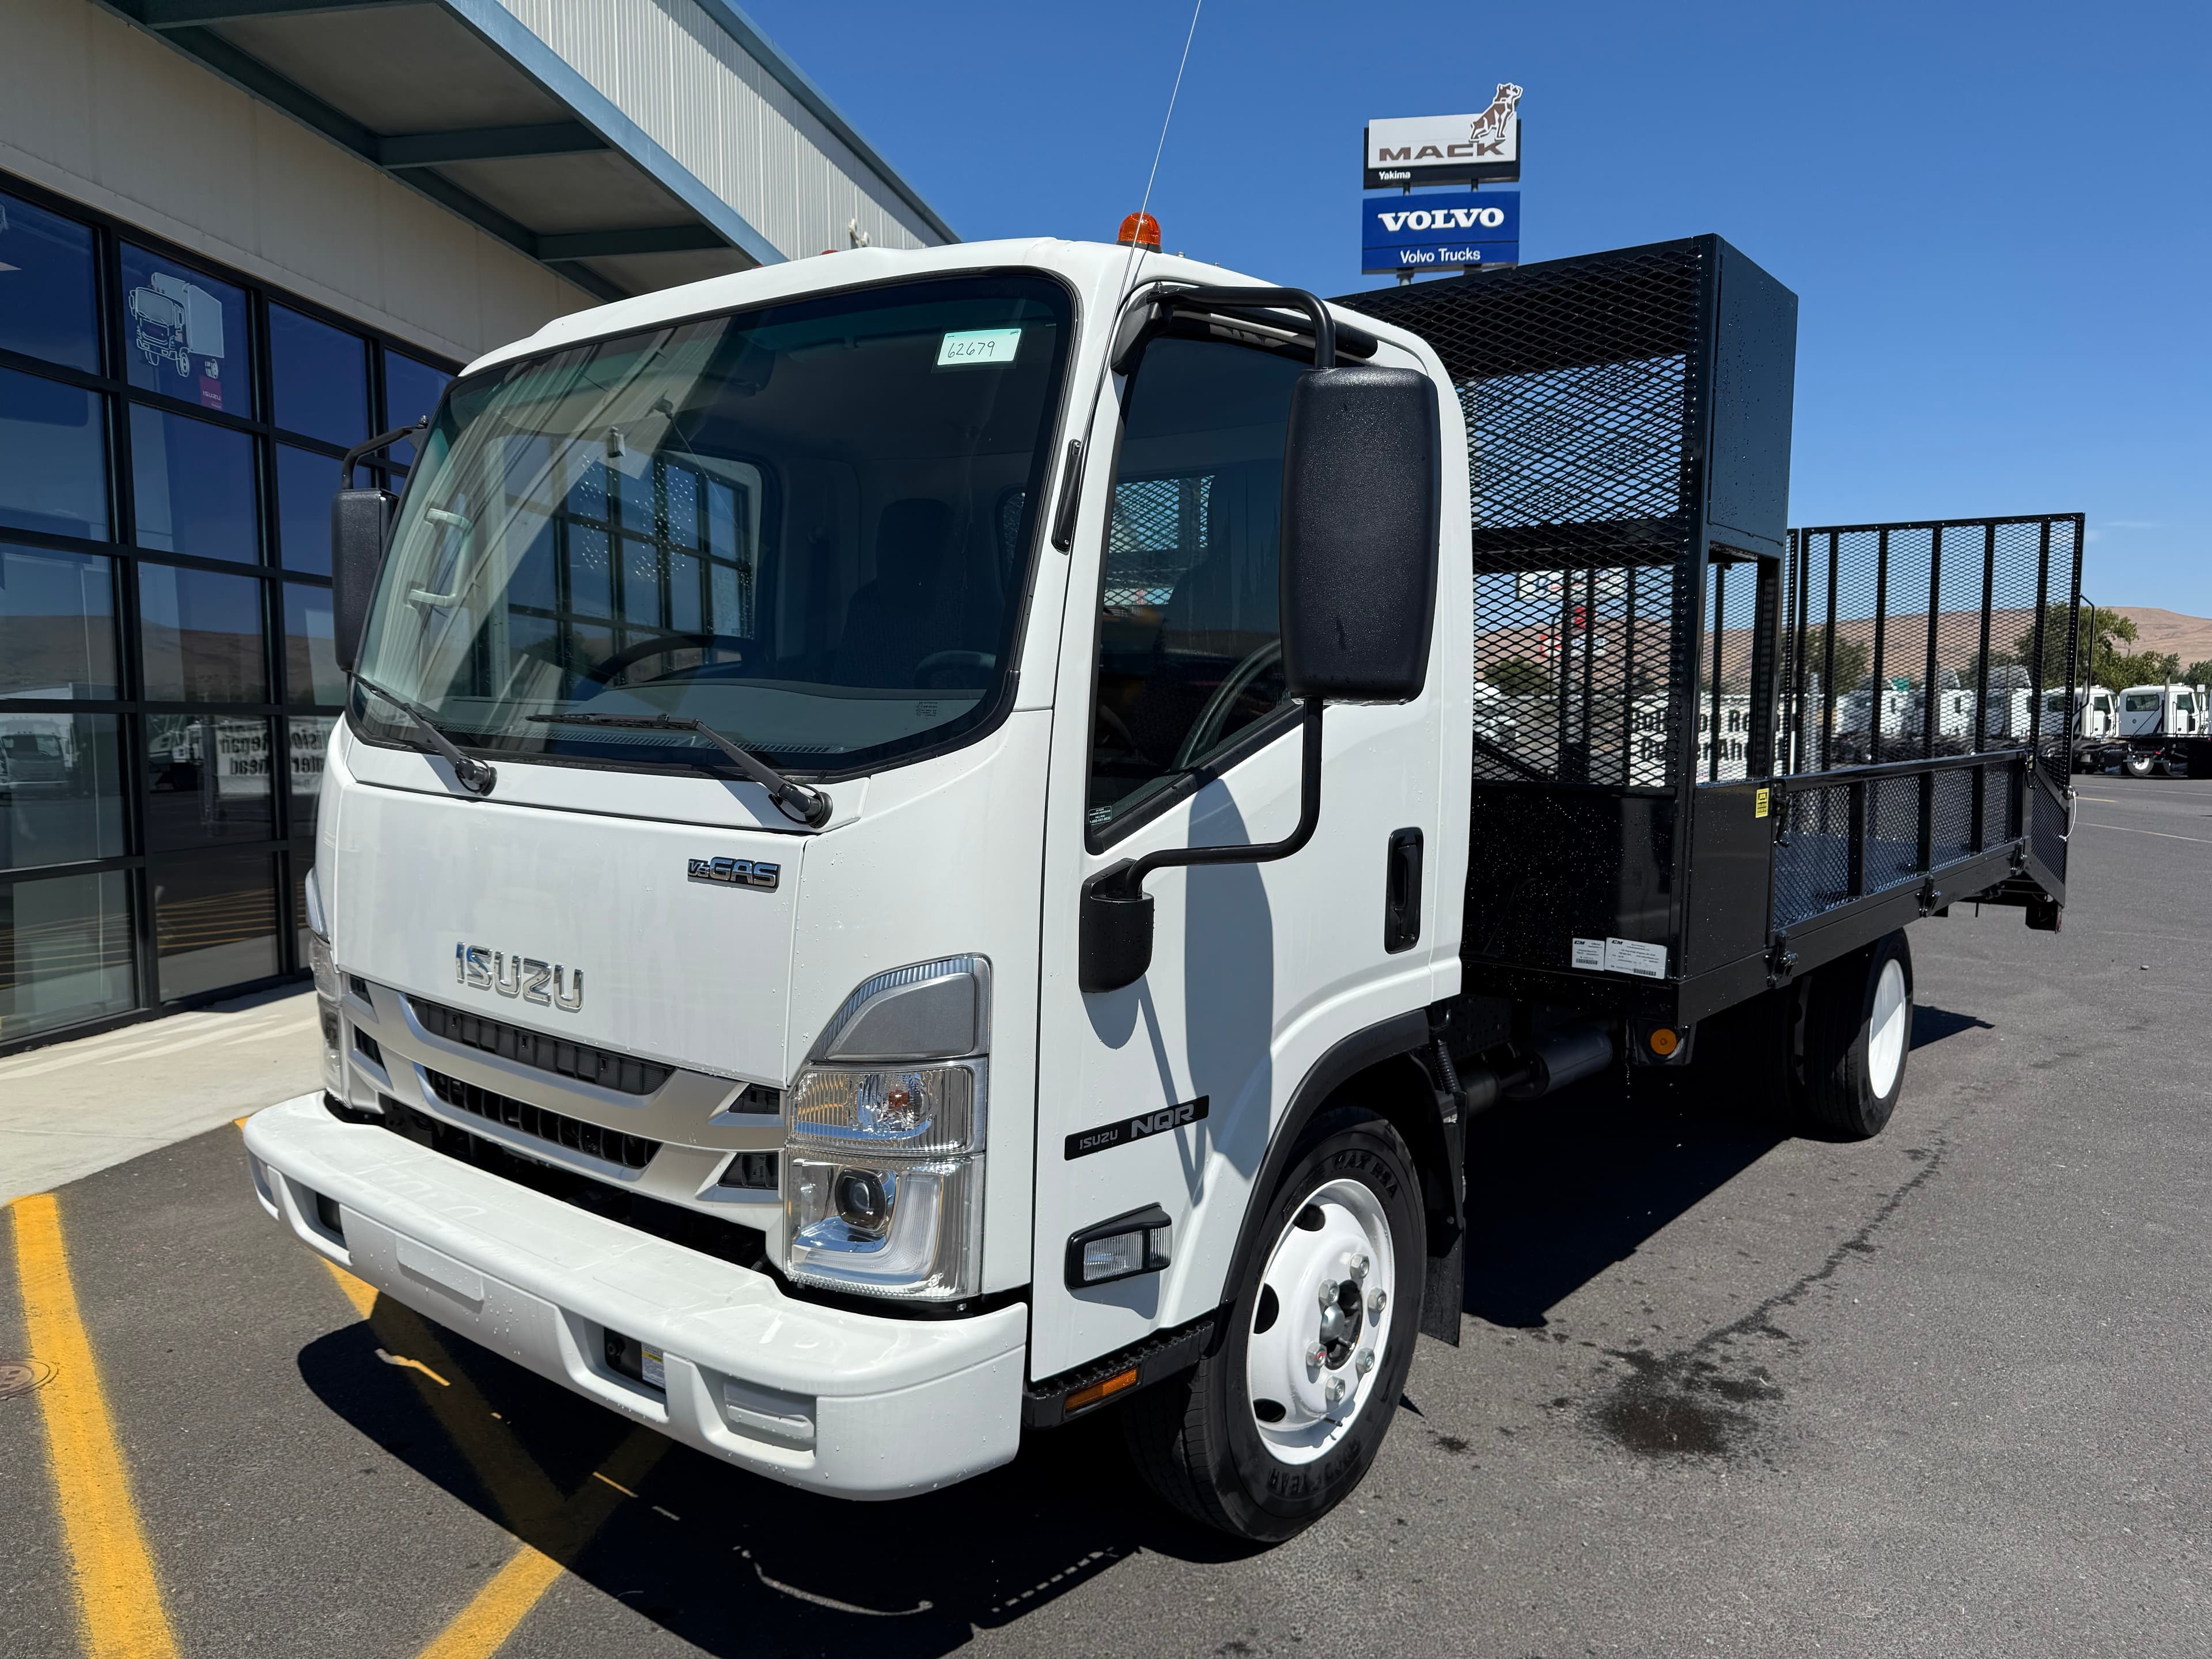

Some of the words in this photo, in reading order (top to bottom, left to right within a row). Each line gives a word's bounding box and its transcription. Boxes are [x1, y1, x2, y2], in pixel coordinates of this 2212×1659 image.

[1379, 142, 1505, 161] MACK
[1378, 171, 1411, 180] Yakima
[1378, 207, 1505, 232] VOLVO
[1400, 249, 1435, 264] Volvo
[1438, 247, 1480, 261] Trucks
[948, 341, 995, 358] 62679
[202, 391, 221, 402] ISUZU
[709, 858, 777, 887] GAS
[455, 941, 584, 1012] ISUZU
[1080, 1130, 1118, 1150] ISUZU
[1131, 1104, 1194, 1138] NQR
